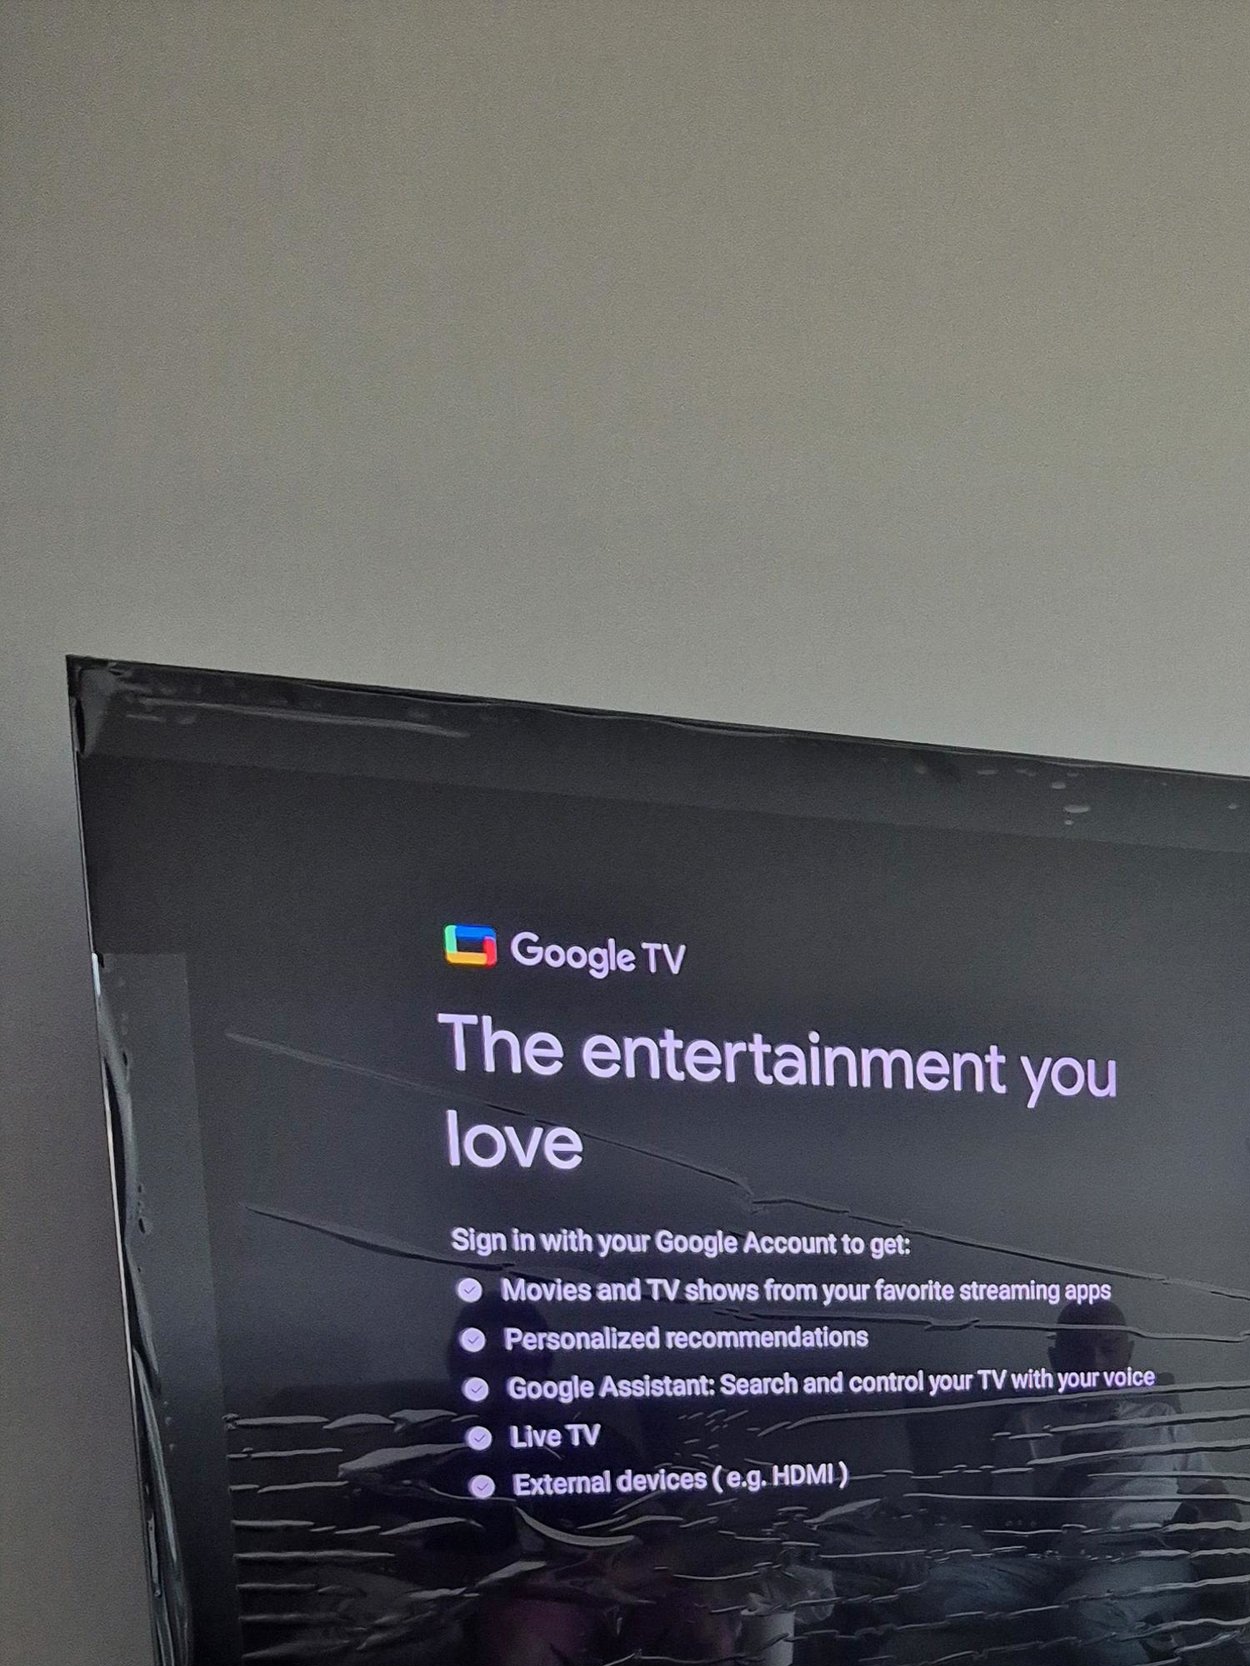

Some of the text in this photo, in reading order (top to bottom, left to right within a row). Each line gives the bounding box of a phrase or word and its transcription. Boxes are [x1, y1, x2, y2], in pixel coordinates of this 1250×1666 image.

[510, 931, 686, 980] Google TV
[437, 1012, 1117, 1109] The entertainment you
[446, 1109, 584, 1170] love
[451, 1227, 911, 1260] Sign in with your Google Account to get:
[501, 1277, 1112, 1307] Movies and TV shows from your favorite streaming apps
[504, 1325, 869, 1351] Personalized recommendations
[507, 1366, 1156, 1404] Google Assistant: Search and control your TV with your voice
[510, 1423, 602, 1449] Live TV
[513, 1469, 612, 1496] External
[615, 1468, 708, 1493] devices
[726, 1469, 767, 1492] e.g.
[772, 1463, 834, 1487] HDMI
